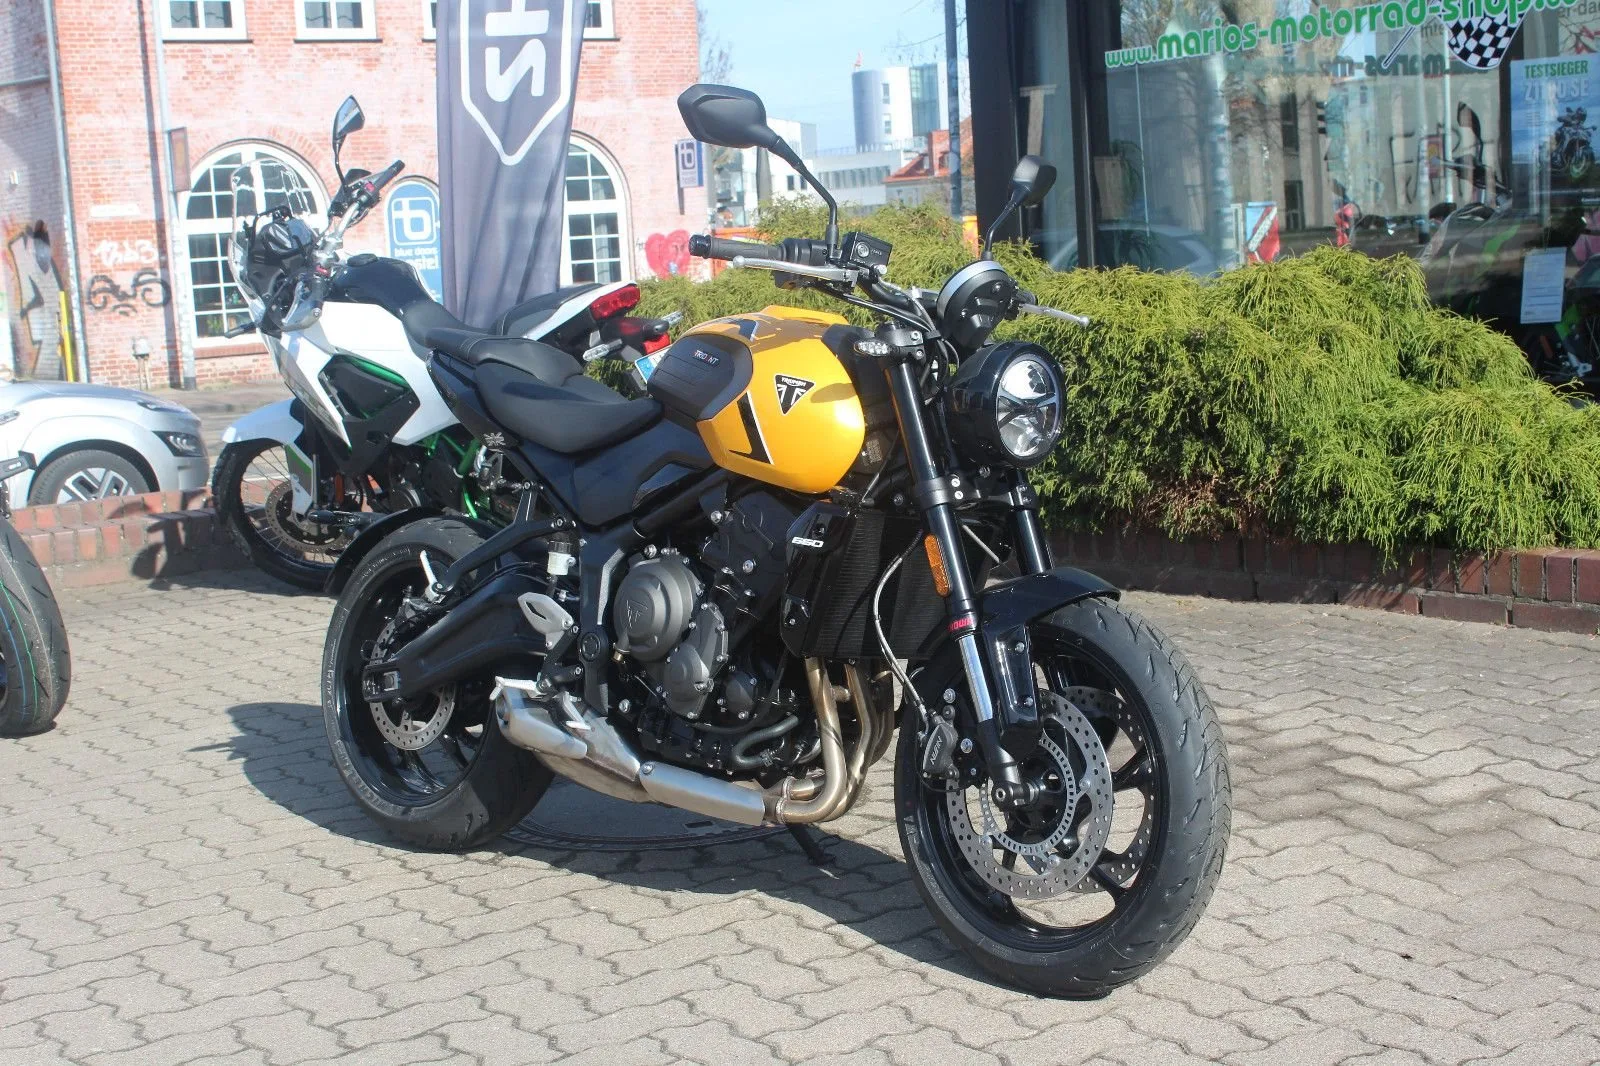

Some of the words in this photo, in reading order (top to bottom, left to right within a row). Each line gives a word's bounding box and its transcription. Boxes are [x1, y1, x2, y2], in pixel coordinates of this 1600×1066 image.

[1105, 0, 1577, 67] www.marios-motorrad-shop.
[1524, 60, 1588, 79] TESTSIEGER
[791, 536, 824, 548] 650
